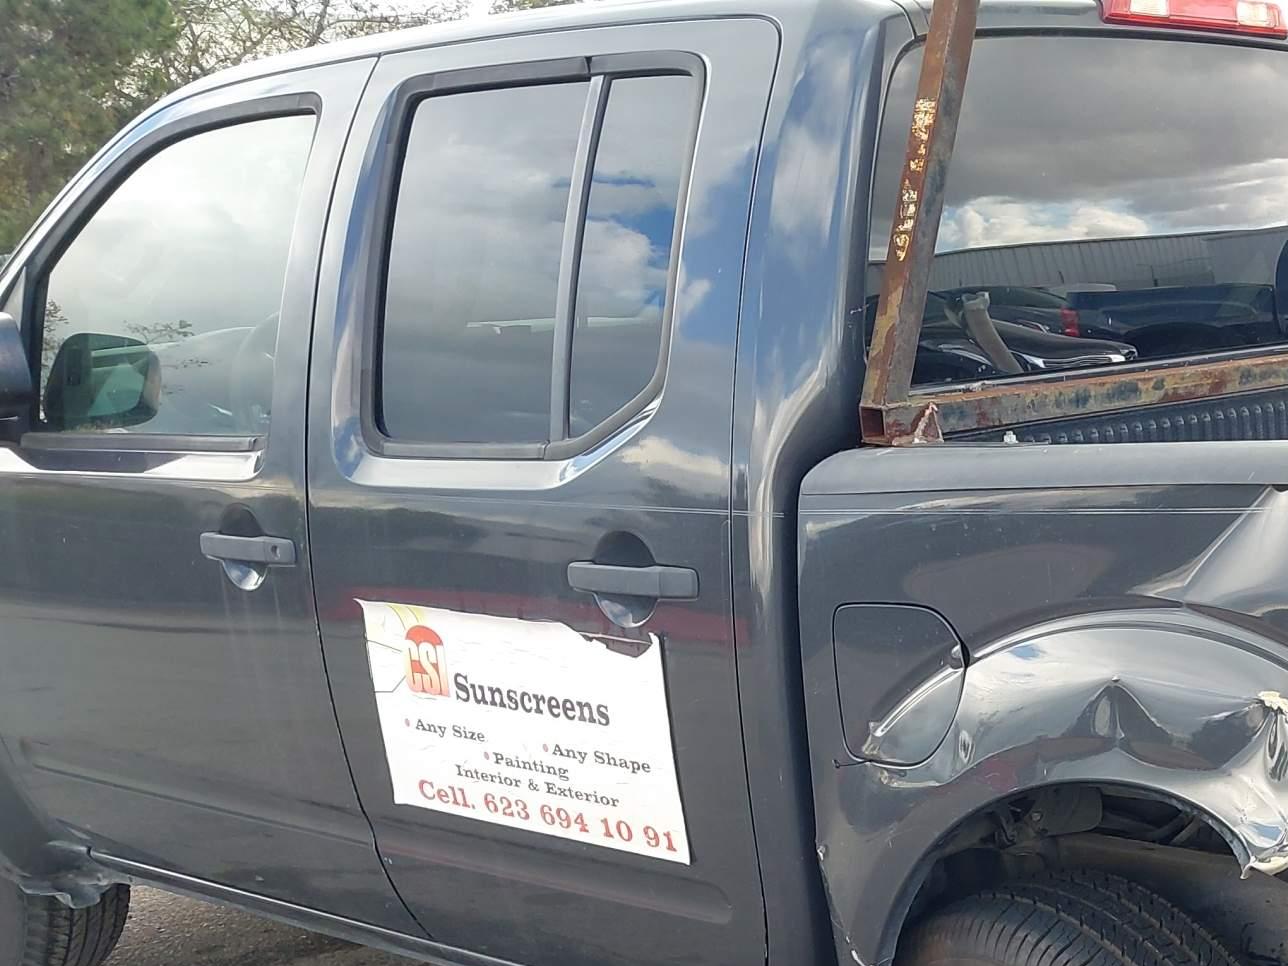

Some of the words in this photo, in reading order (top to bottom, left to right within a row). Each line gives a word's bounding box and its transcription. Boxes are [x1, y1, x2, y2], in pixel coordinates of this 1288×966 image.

[453, 672, 610, 727] Sunscreens
[415, 718, 447, 739] Any
[451, 723, 486, 743] Size
[493, 752, 570, 781] Painting
[552, 743, 588, 764] Any
[594, 751, 651, 774] Shape
[454, 763, 522, 789] Interior
[527, 778, 540, 792] &
[545, 781, 620, 809] Exterior
[417, 779, 476, 811] Cell.
[483, 792, 530, 822] 623
[540, 804, 589, 834] 694
[600, 817, 633, 842] 10
[643, 825, 678, 854] 91
